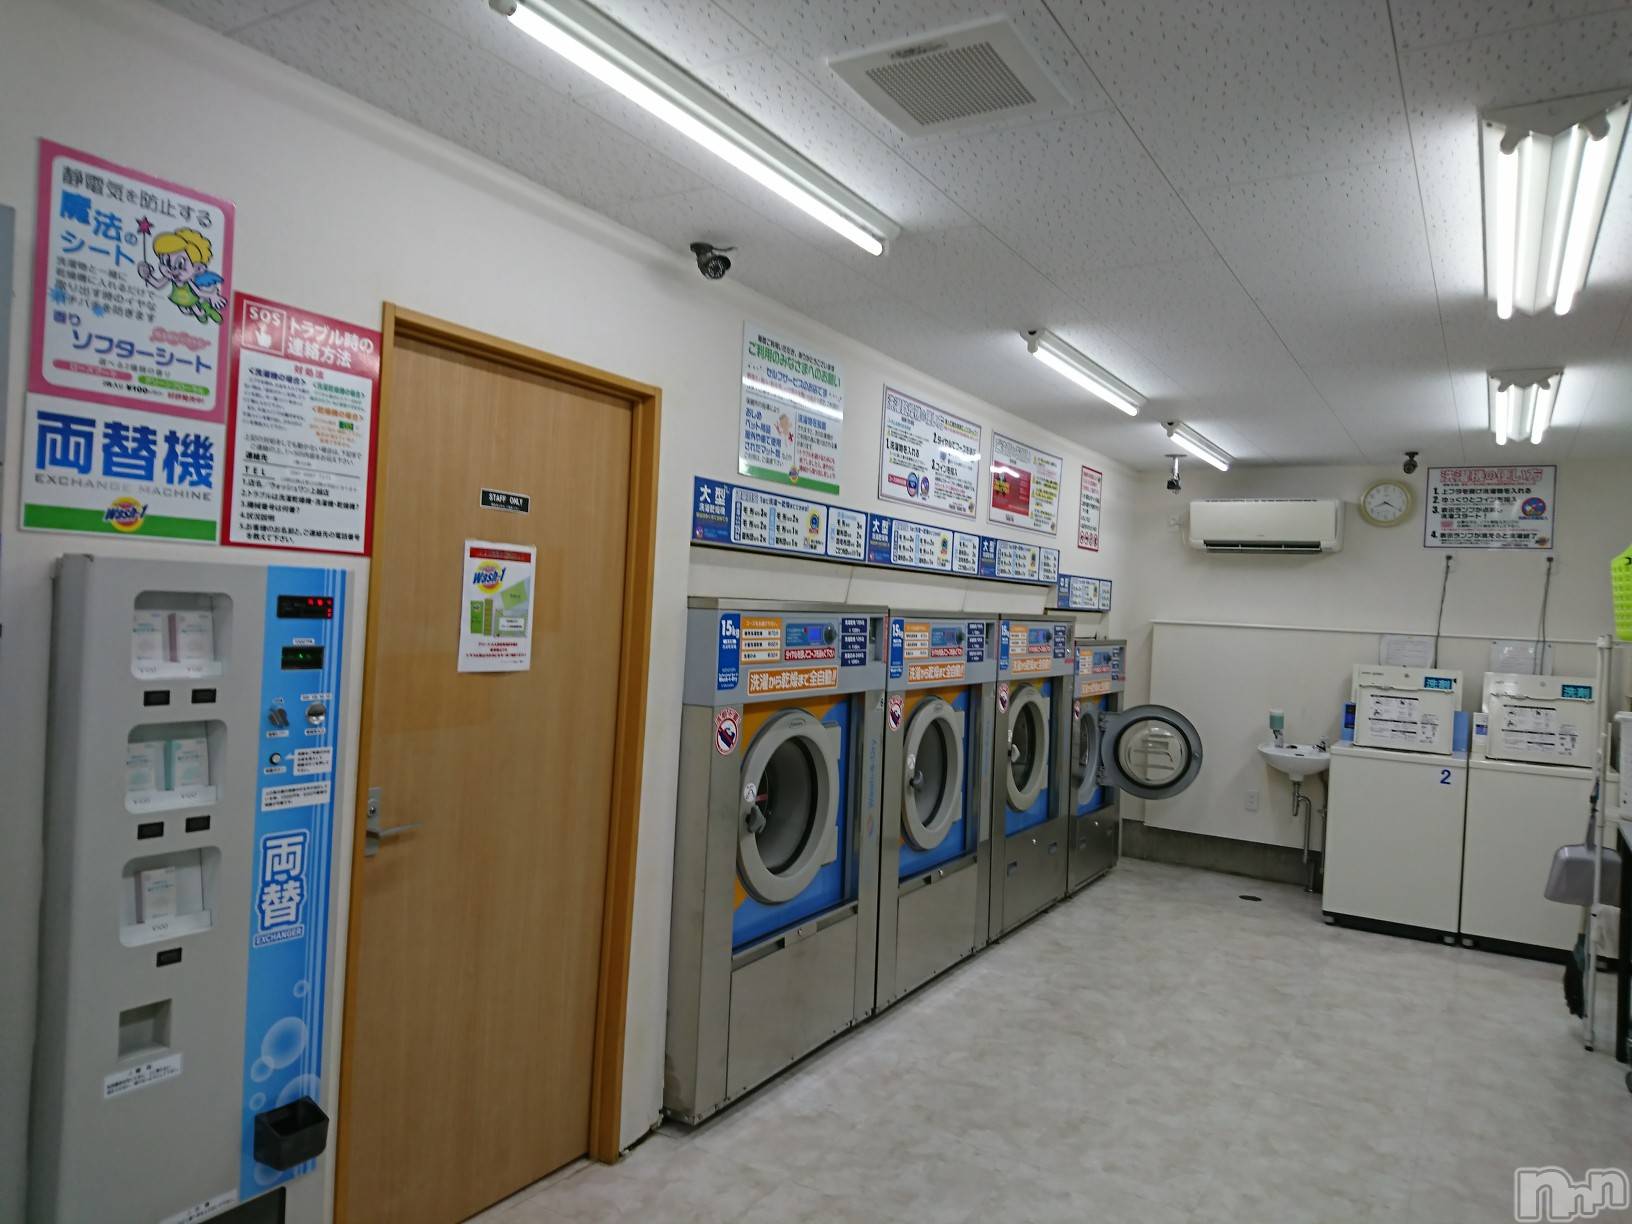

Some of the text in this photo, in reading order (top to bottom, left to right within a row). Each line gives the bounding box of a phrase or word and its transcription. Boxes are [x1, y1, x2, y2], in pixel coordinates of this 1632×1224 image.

[60, 230, 135, 267] シート
[249, 306, 281, 327] SOS
[290, 317, 374, 354] トラブル時の
[72, 329, 213, 374] ソフターシート
[287, 336, 352, 369] 連絡方法
[36, 410, 214, 490] 両替機
[34, 473, 212, 502] EXCHANGE MACHINE
[488, 492, 506, 503] STAFF
[510, 497, 524, 507] ONLY
[699, 484, 726, 506] 大型
[721, 619, 740, 639] 15kg
[1440, 770, 1452, 785] 2
[262, 836, 305, 928] 両替
